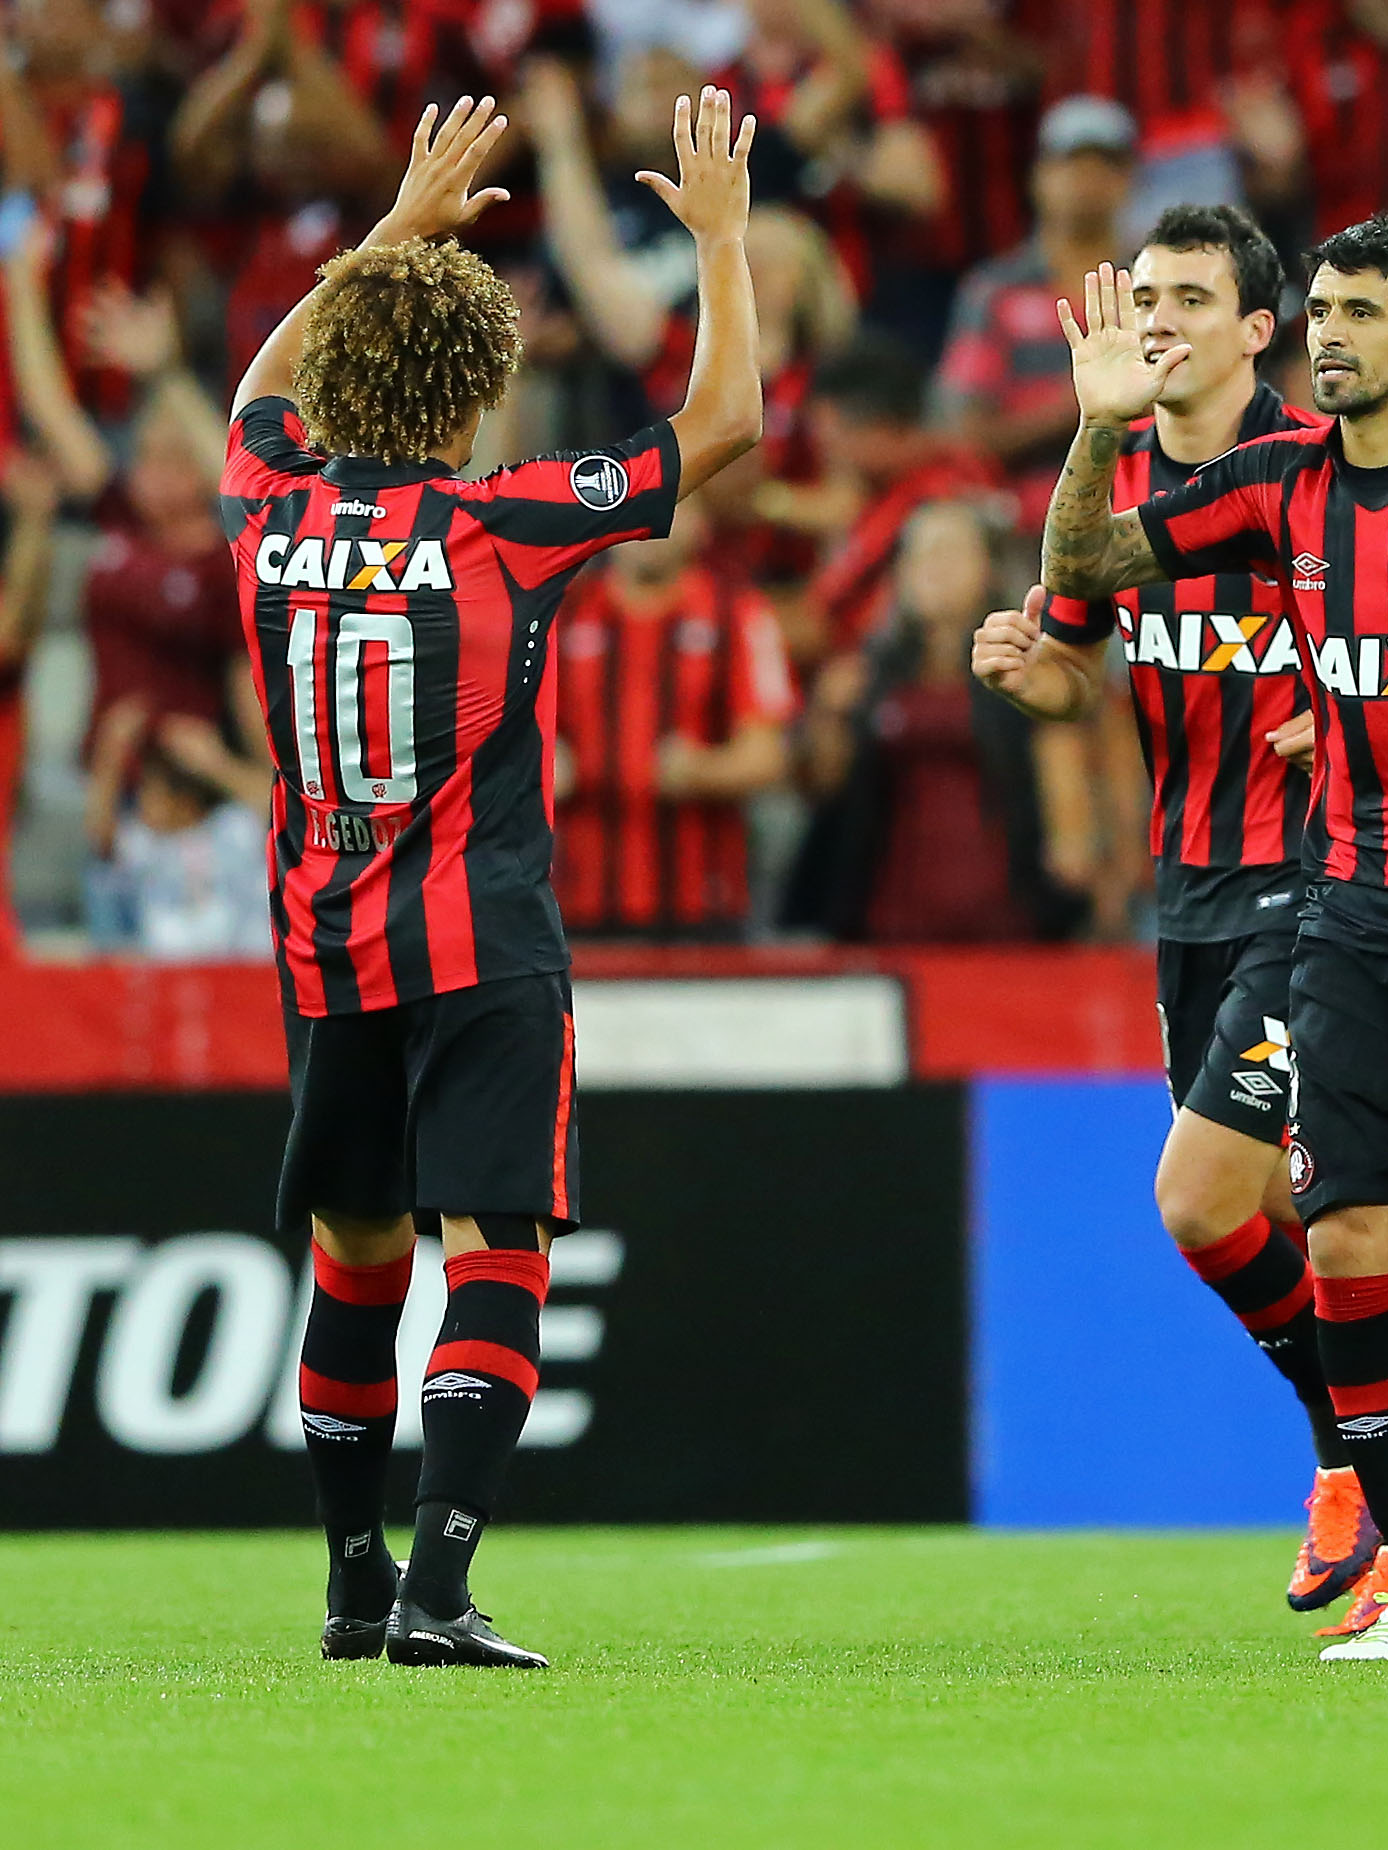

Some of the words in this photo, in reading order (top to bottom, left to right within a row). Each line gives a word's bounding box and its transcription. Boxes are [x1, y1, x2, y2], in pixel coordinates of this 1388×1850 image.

[330, 499, 387, 519] umbro
[255, 533, 452, 591] CAIXA
[1292, 577, 1326, 591] umbro
[287, 608, 418, 803] 10
[1230, 1089, 1272, 1112] umbro
[423, 1390, 482, 1404] umbro
[304, 1423, 359, 1441] umbro
